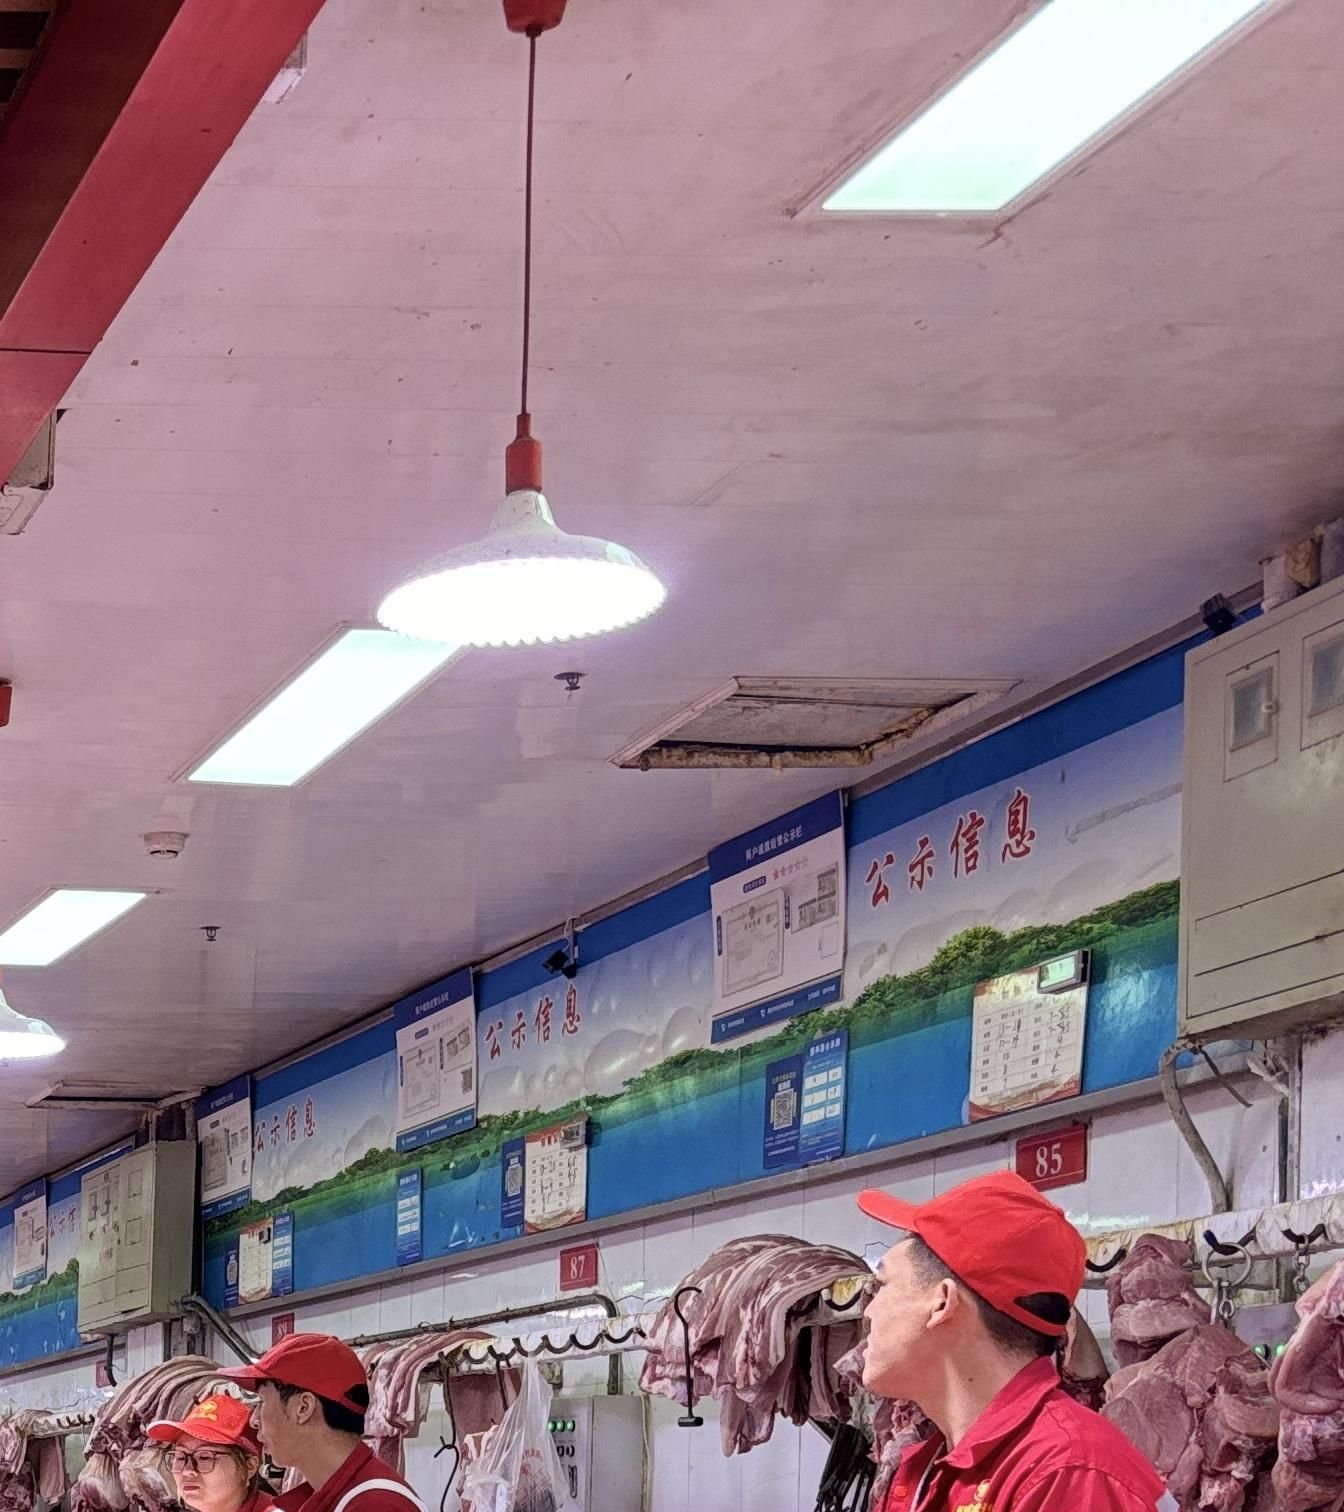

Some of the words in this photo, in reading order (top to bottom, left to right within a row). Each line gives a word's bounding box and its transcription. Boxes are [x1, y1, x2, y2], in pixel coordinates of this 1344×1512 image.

[864, 787, 1036, 908] 公示信息
[485, 983, 581, 1061] 公示信息
[254, 1095, 316, 1152] 公示信息
[1035, 1143, 1063, 1177] 85
[570, 1255, 586, 1280] 87
